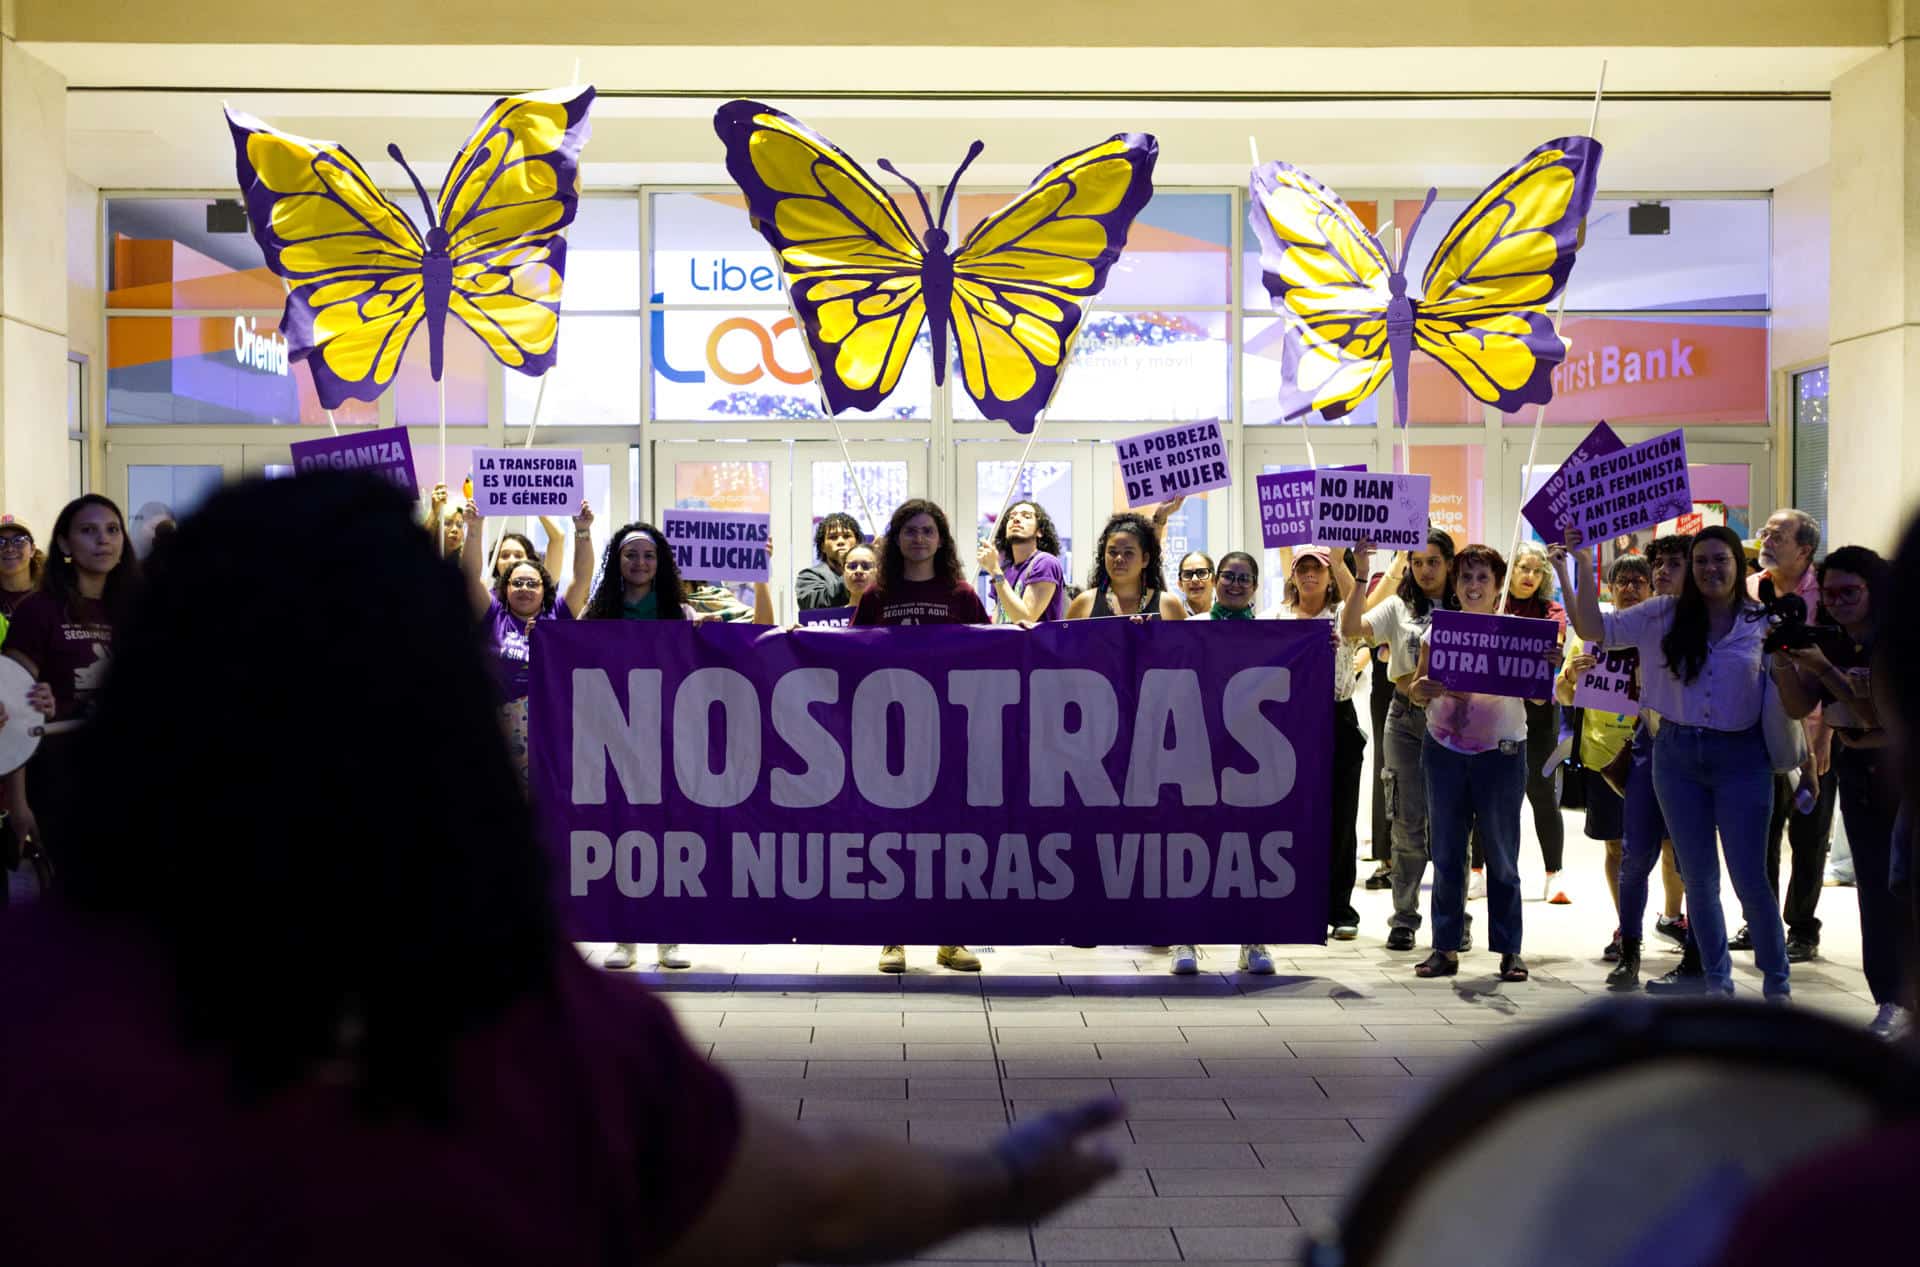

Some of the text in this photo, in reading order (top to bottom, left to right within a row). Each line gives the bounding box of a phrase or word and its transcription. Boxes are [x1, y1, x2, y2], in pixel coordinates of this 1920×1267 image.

[1119, 424, 1218, 460] LA POBREZA
[480, 458, 577, 470] LA TRANSFOBIA
[1122, 442, 1221, 477] TIENE ROSTRO
[1567, 436, 1681, 489] LA REVOLUCIÓN
[483, 475, 574, 488] ES VIOLENCIA
[1127, 461, 1226, 500] DE MUJER
[1260, 480, 1313, 501] HACEM
[1320, 478, 1394, 500] NO HAN
[1545, 475, 1564, 497] NO
[1570, 456, 1684, 508] SERÁ FEMINISTA
[489, 490, 567, 505] DE GÉNERO
[1571, 476, 1687, 527] Y ANTIRRACISTA
[1318, 502, 1389, 524] PODIDO
[1588, 506, 1649, 541] NO SERÁ
[665, 520, 769, 542] FEMINISTAS
[1264, 522, 1305, 536] TODOS
[700, 546, 768, 570] LUCHA
[883, 608, 925, 619] SEGUIMOS
[1433, 629, 1552, 653] CONSTRUYAMOS
[1431, 649, 1550, 681] OTRA VIDA
[1584, 674, 1610, 693] PAL
[572, 666, 1297, 809] NOSOTRAS
[570, 830, 1296, 900] POR NUESTRAS VIDAS
